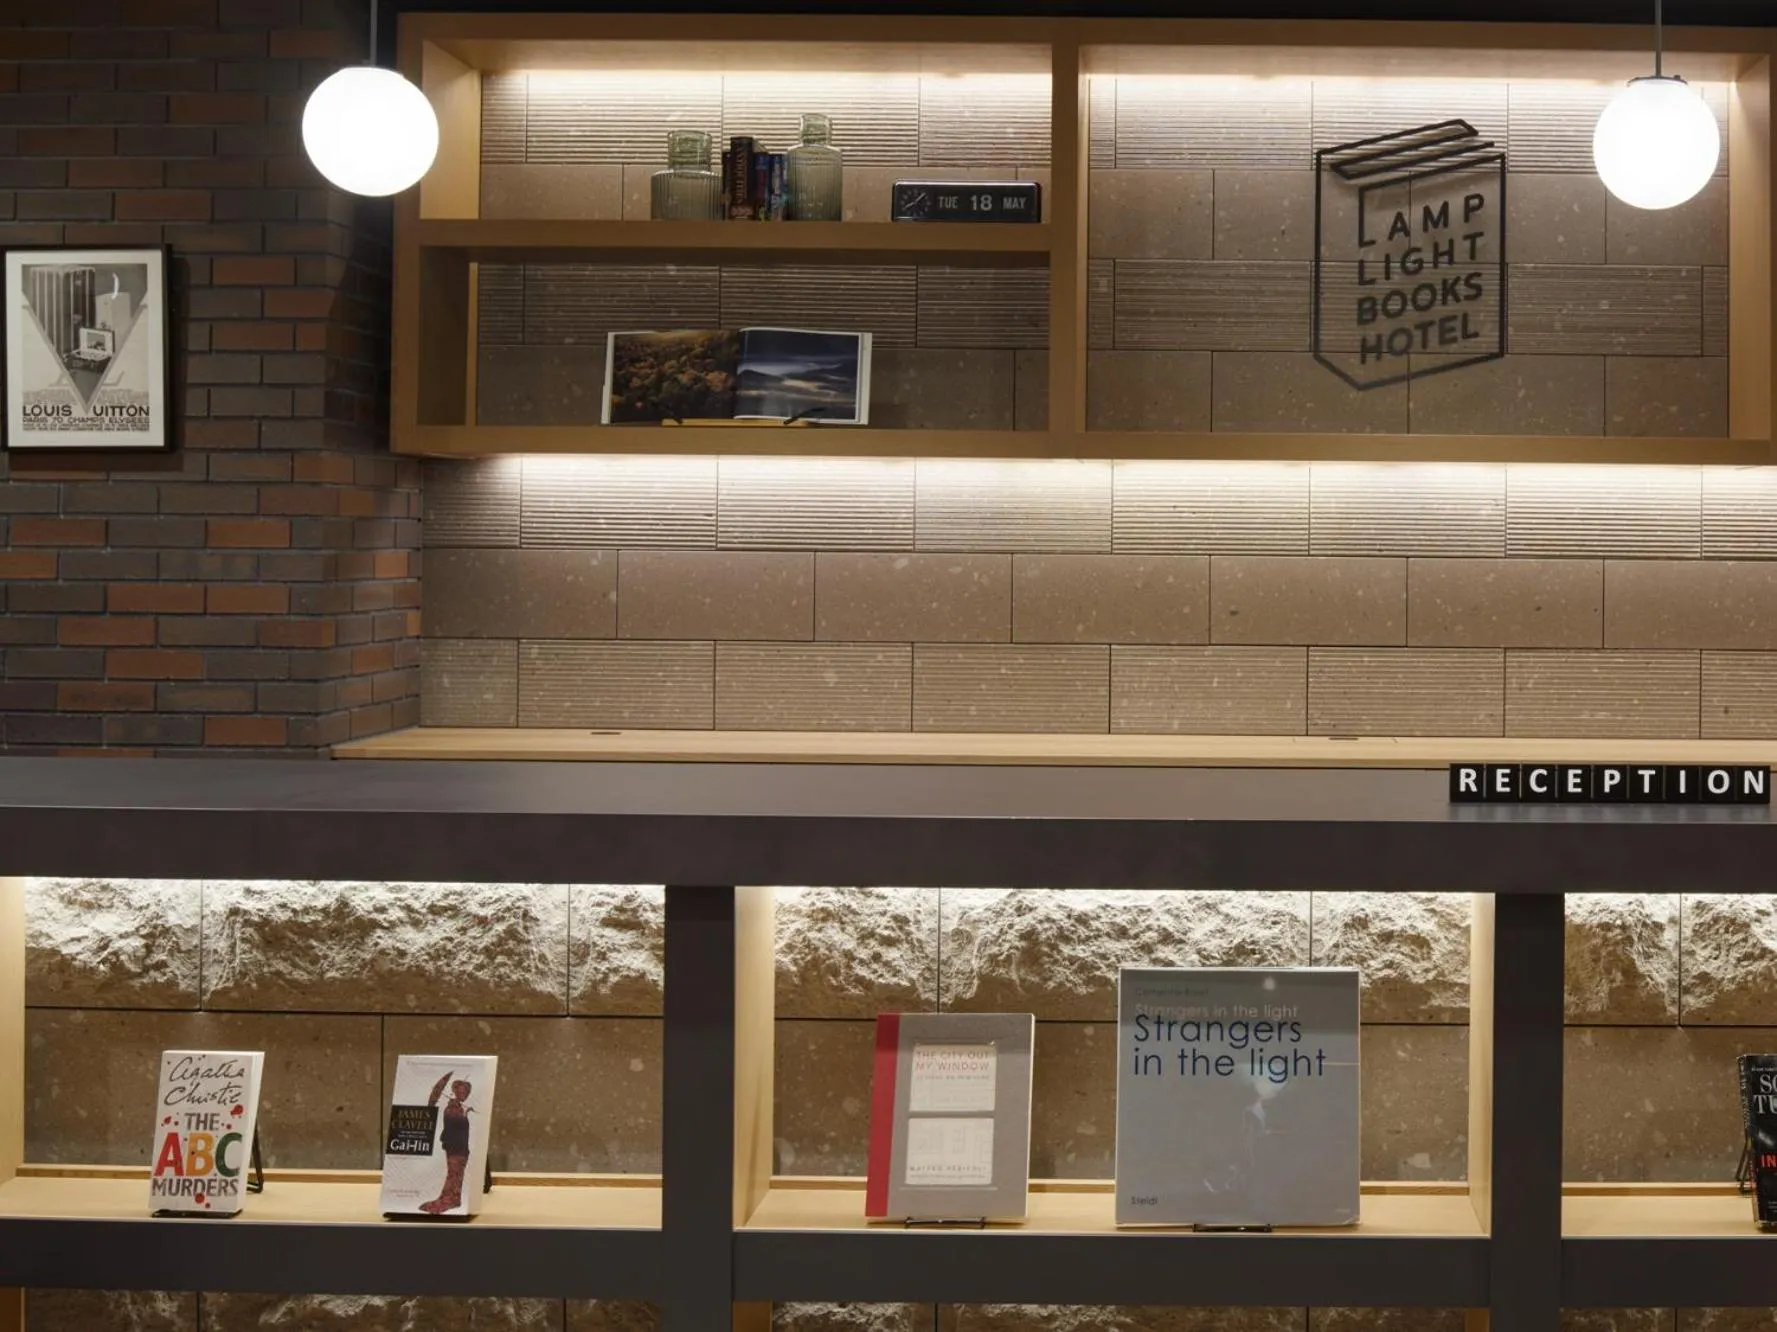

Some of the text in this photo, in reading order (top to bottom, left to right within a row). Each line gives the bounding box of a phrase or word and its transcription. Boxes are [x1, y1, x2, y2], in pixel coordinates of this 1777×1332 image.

[937, 194, 1027, 211] TUE 18 MAY
[1358, 193, 1485, 248] LAMP
[1357, 232, 1485, 286] LIGHT
[1356, 272, 1483, 326] BOOKS
[1359, 313, 1480, 365] HOTEL
[22, 404, 73, 417] LOUIS
[1459, 768, 1764, 795] RECEPTION
[1212, 1004, 1228, 1018] in
[1232, 1004, 1258, 1018] the
[1264, 1003, 1299, 1021] light
[1134, 1013, 1302, 1049] Strangers
[915, 1050, 989, 1060] THE CITY OUT
[916, 1061, 990, 1072] MY WINDOW
[1133, 1047, 1327, 1083] in the light
[168, 1056, 245, 1086] Agatha
[164, 1081, 243, 1106] Christie
[184, 1112, 221, 1131] THE
[154, 1132, 243, 1177] ABC
[152, 1178, 239, 1197] MURDERS
